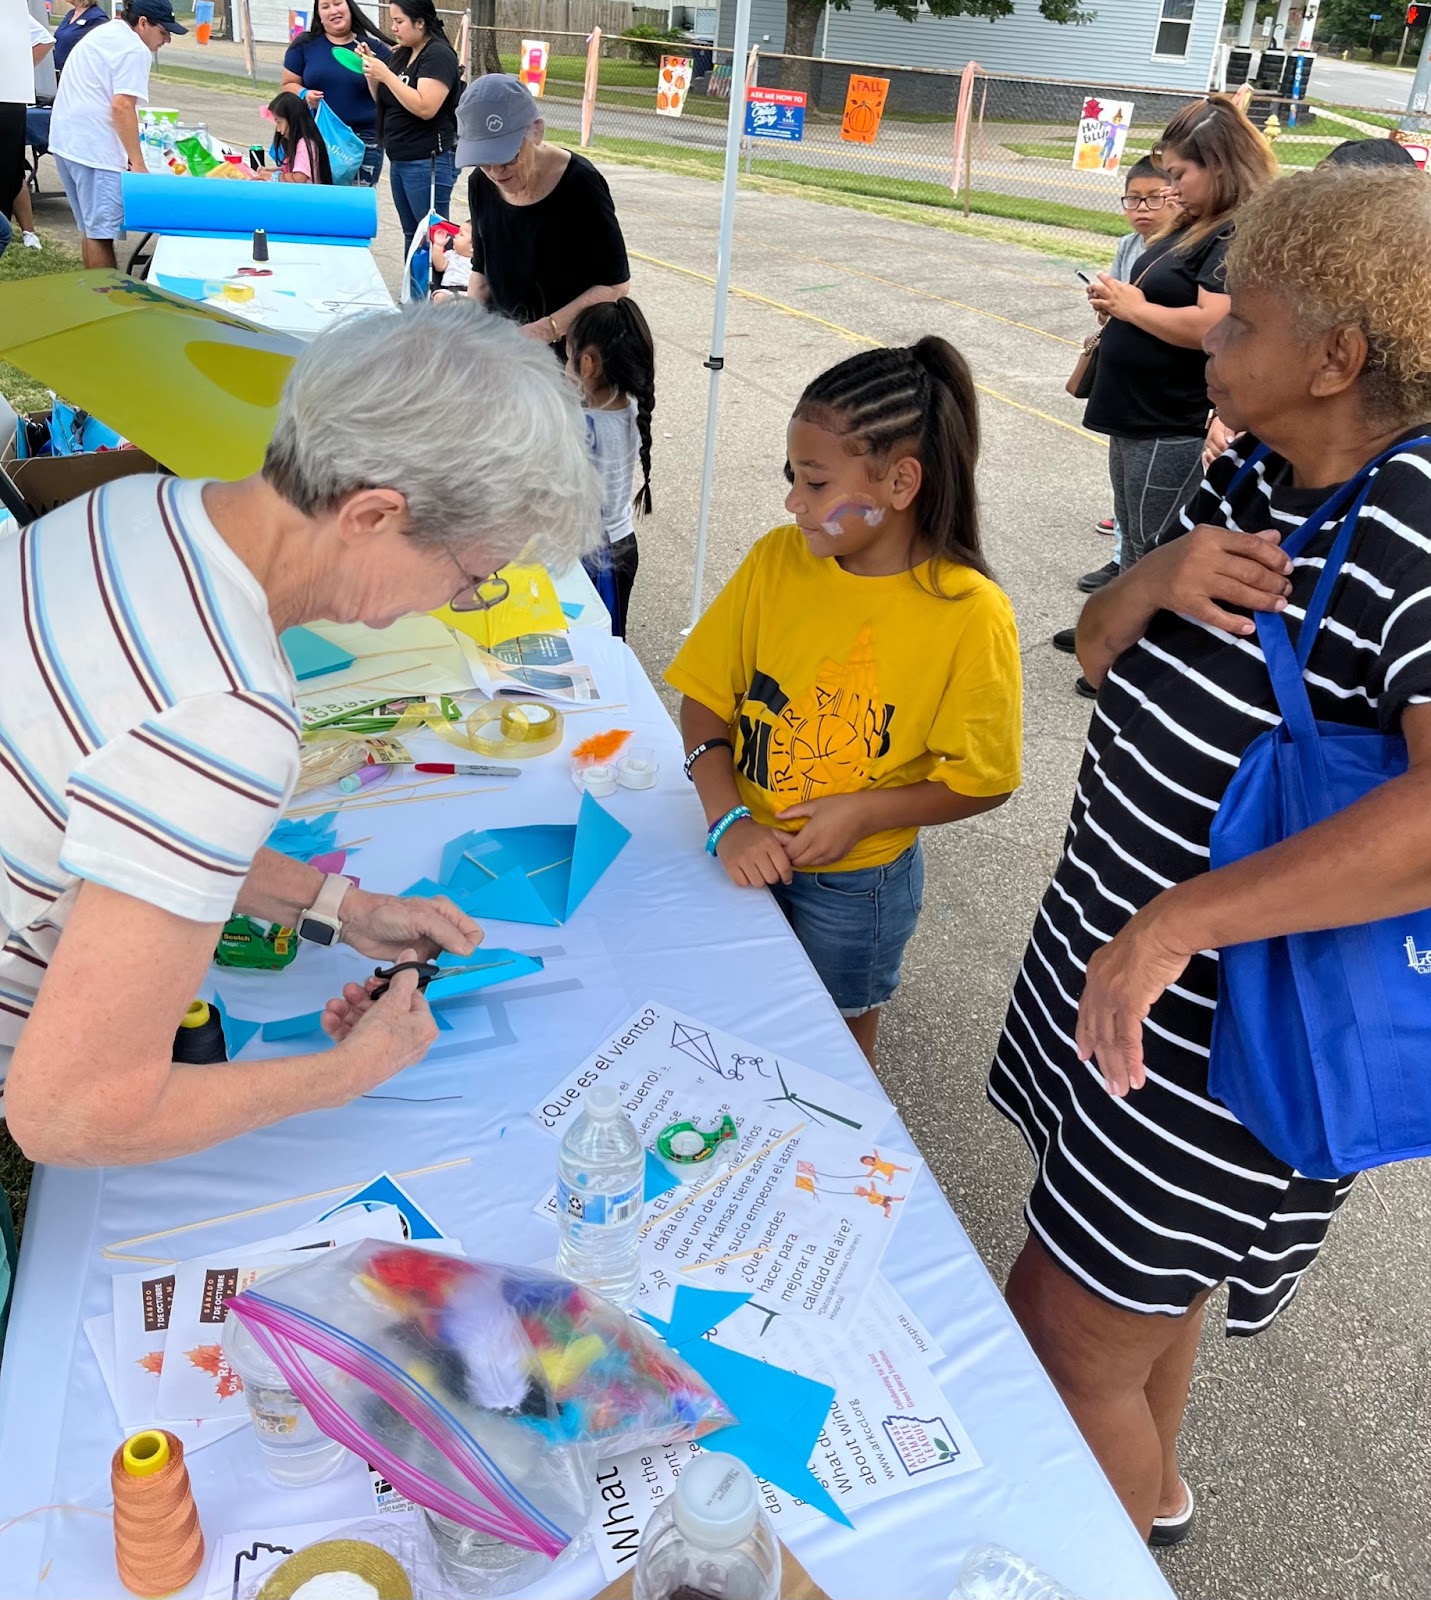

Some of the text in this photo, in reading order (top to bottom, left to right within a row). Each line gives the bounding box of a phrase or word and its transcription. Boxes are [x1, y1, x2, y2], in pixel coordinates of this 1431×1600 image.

[776, 94, 792, 102] HOW
[856, 80, 883, 92] FALL
[686, 743, 706, 769] BACK
[223, 933, 251, 942] Scotch
[577, 1071, 598, 1088] es
[595, 1054, 615, 1070] el
[608, 1008, 660, 1055] viento?
[622, 1070, 661, 1111] bueno!
[638, 1111, 658, 1138] ueno
[655, 1089, 674, 1112] para
[654, 1198, 669, 1211] El
[675, 1237, 693, 1259] que
[689, 1215, 707, 1236] uno
[703, 1198, 716, 1213] de
[741, 1124, 762, 1151] niños
[703, 1204, 739, 1252] Arkansas
[732, 1175, 755, 1202] tiene
[768, 1128, 783, 1140] El
[728, 1223, 751, 1252] sucio
[746, 1176, 778, 1221] empeora
[773, 1164, 785, 1176] el
[779, 1137, 801, 1163] asma.
[654, 1223, 678, 1251] daña
[670, 1205, 688, 1222] los
[741, 1252, 764, 1283] ¿Que
[756, 1232, 799, 1293] hacer para
[780, 1243, 817, 1301] mejorar la
[802, 1218, 853, 1310] calidad del aire?
[829, 1285, 838, 1295] del
[835, 1260, 849, 1286] Arkansas
[154, 1283, 163, 1315] OCTUBRE
[213, 1306, 221, 1315] DE
[215, 1274, 225, 1306] OCTUBRE
[828, 1295, 845, 1320] Hospital
[890, 1425, 918, 1468] Arkansas
[900, 1423, 928, 1464] CLIMATE
[911, 1423, 937, 1458] LEAGUE
[641, 1456, 665, 1501] is the
[825, 1450, 853, 1495] What
[845, 1438, 877, 1486] about
[596, 1466, 640, 1564] What
